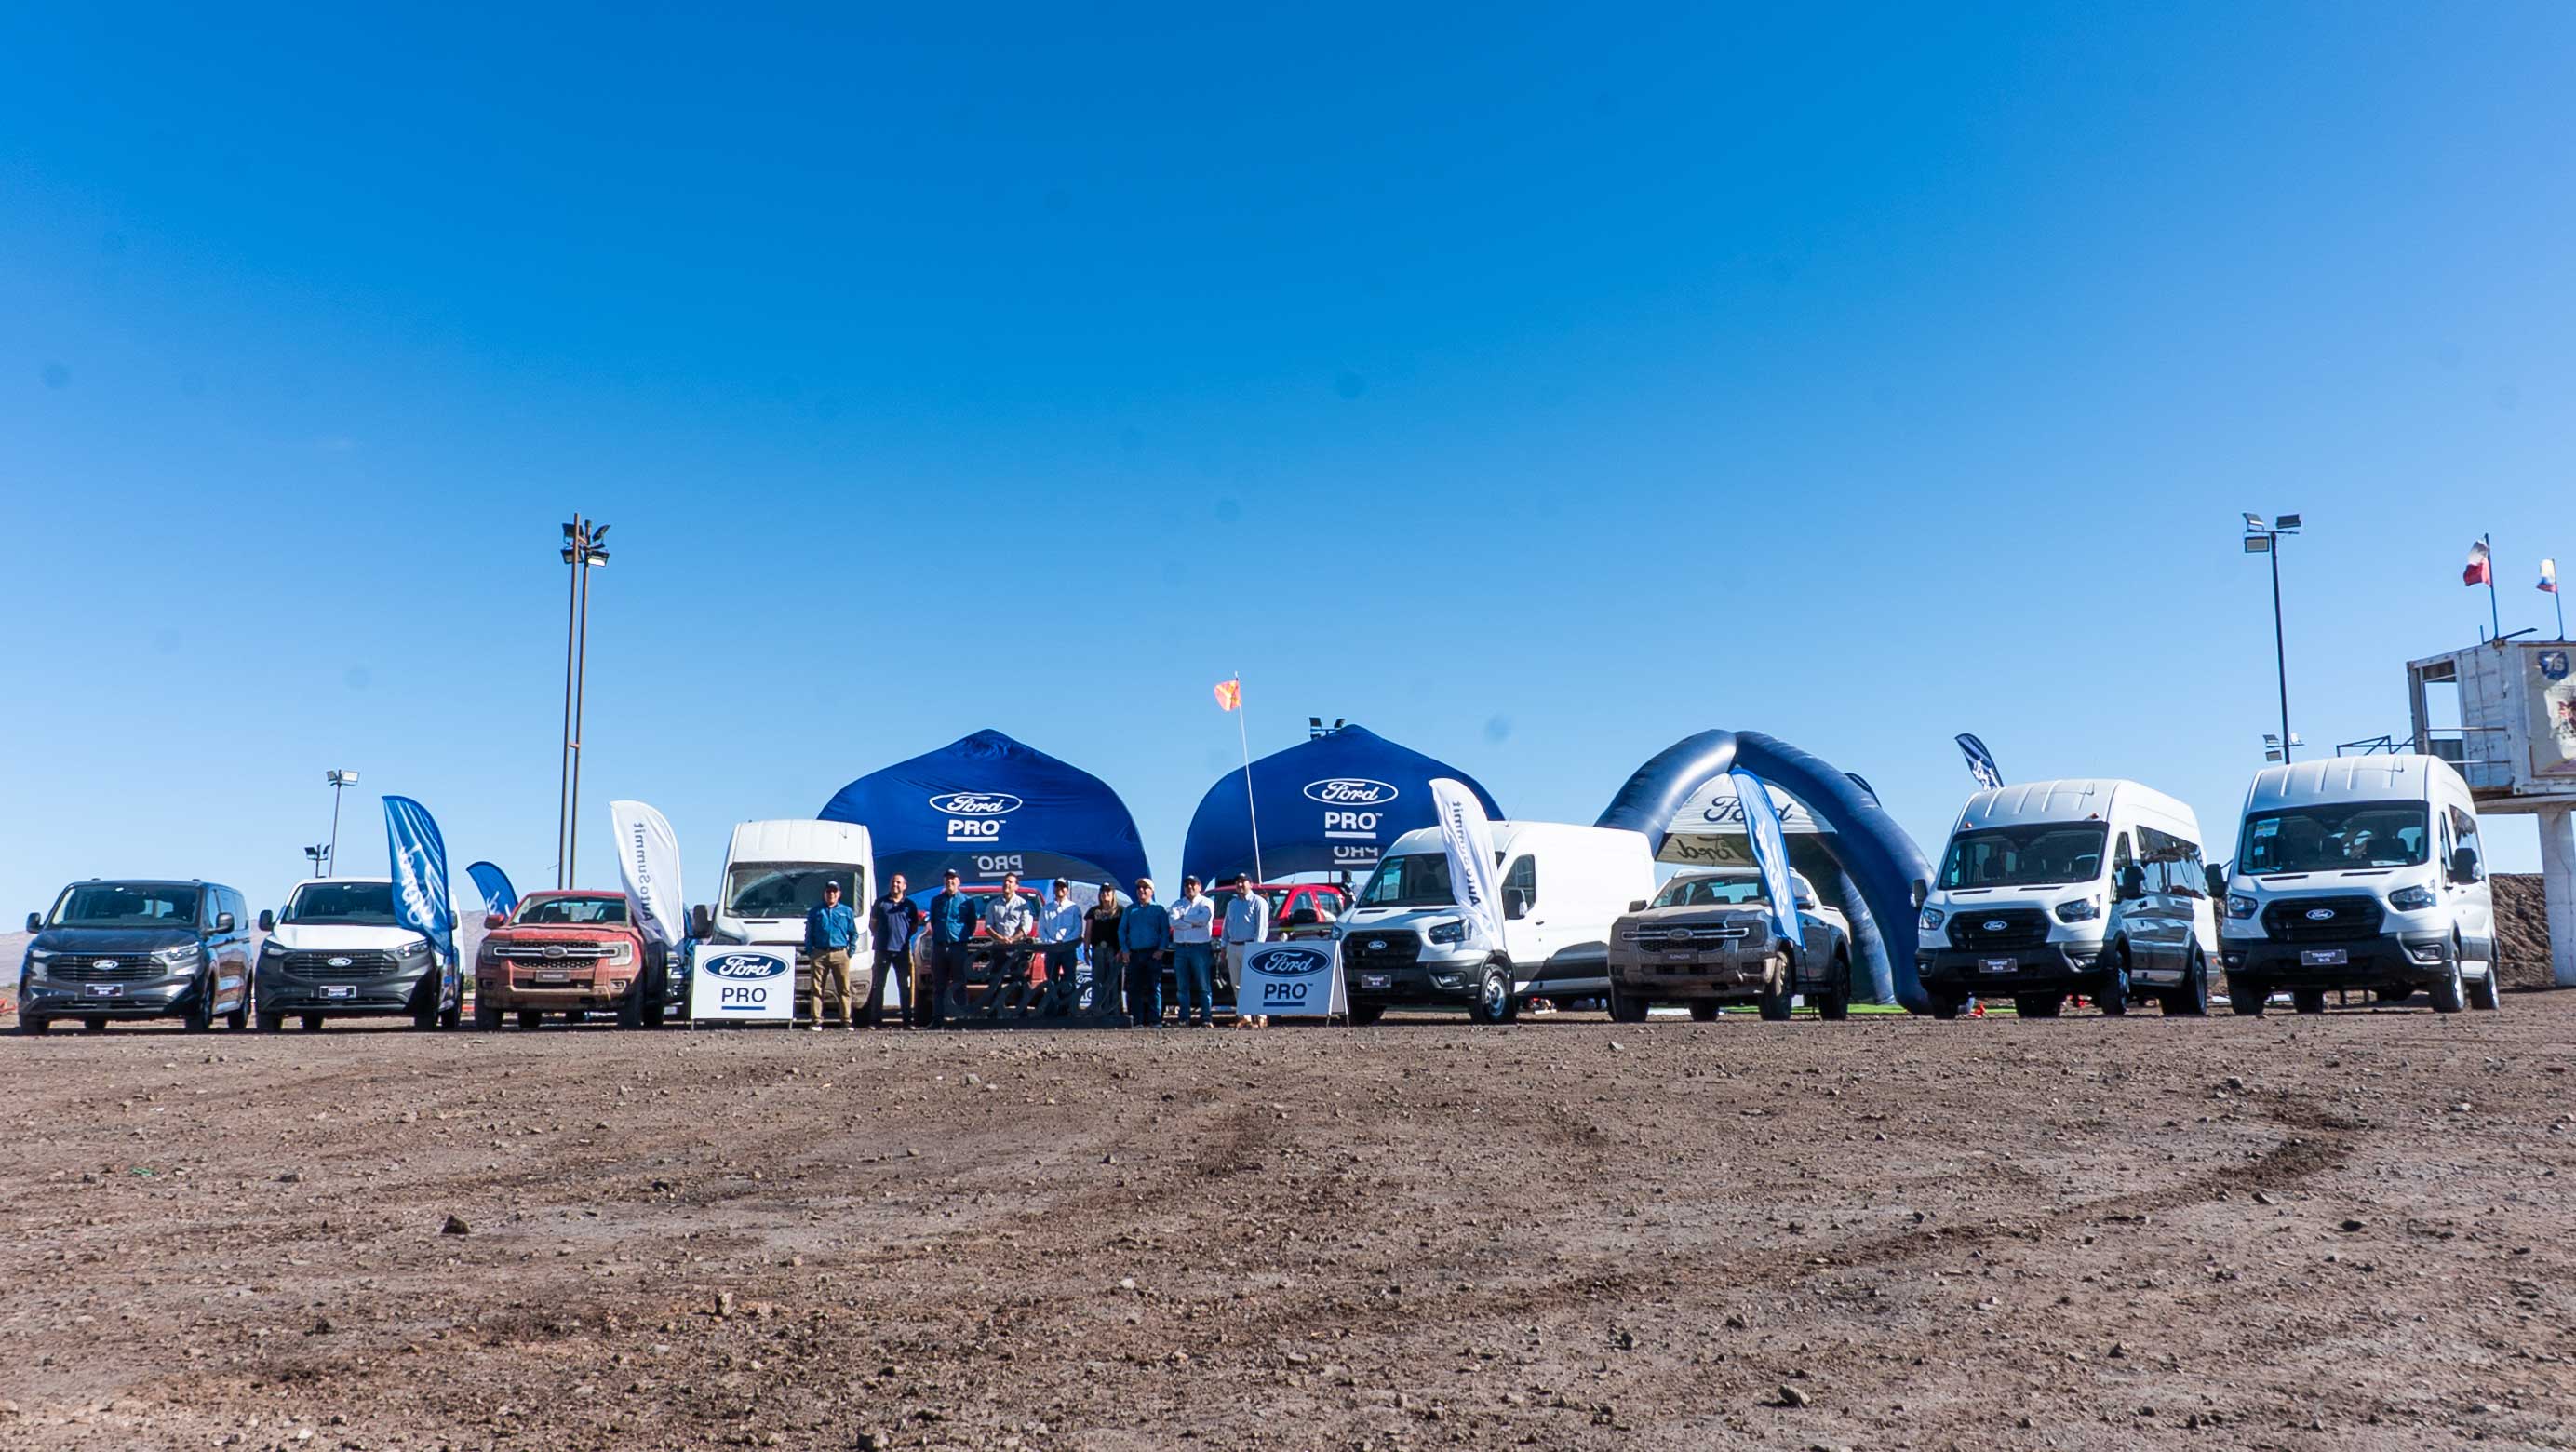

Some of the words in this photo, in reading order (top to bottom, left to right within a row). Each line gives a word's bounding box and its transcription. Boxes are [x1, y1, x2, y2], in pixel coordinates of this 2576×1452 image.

[1322, 781, 1380, 800] Ford
[947, 796, 1004, 812] Ford
[1704, 796, 1793, 822] Fod
[718, 955, 773, 976] Ford
[1264, 951, 1315, 972] Ford
[721, 987, 767, 1003] PRO
